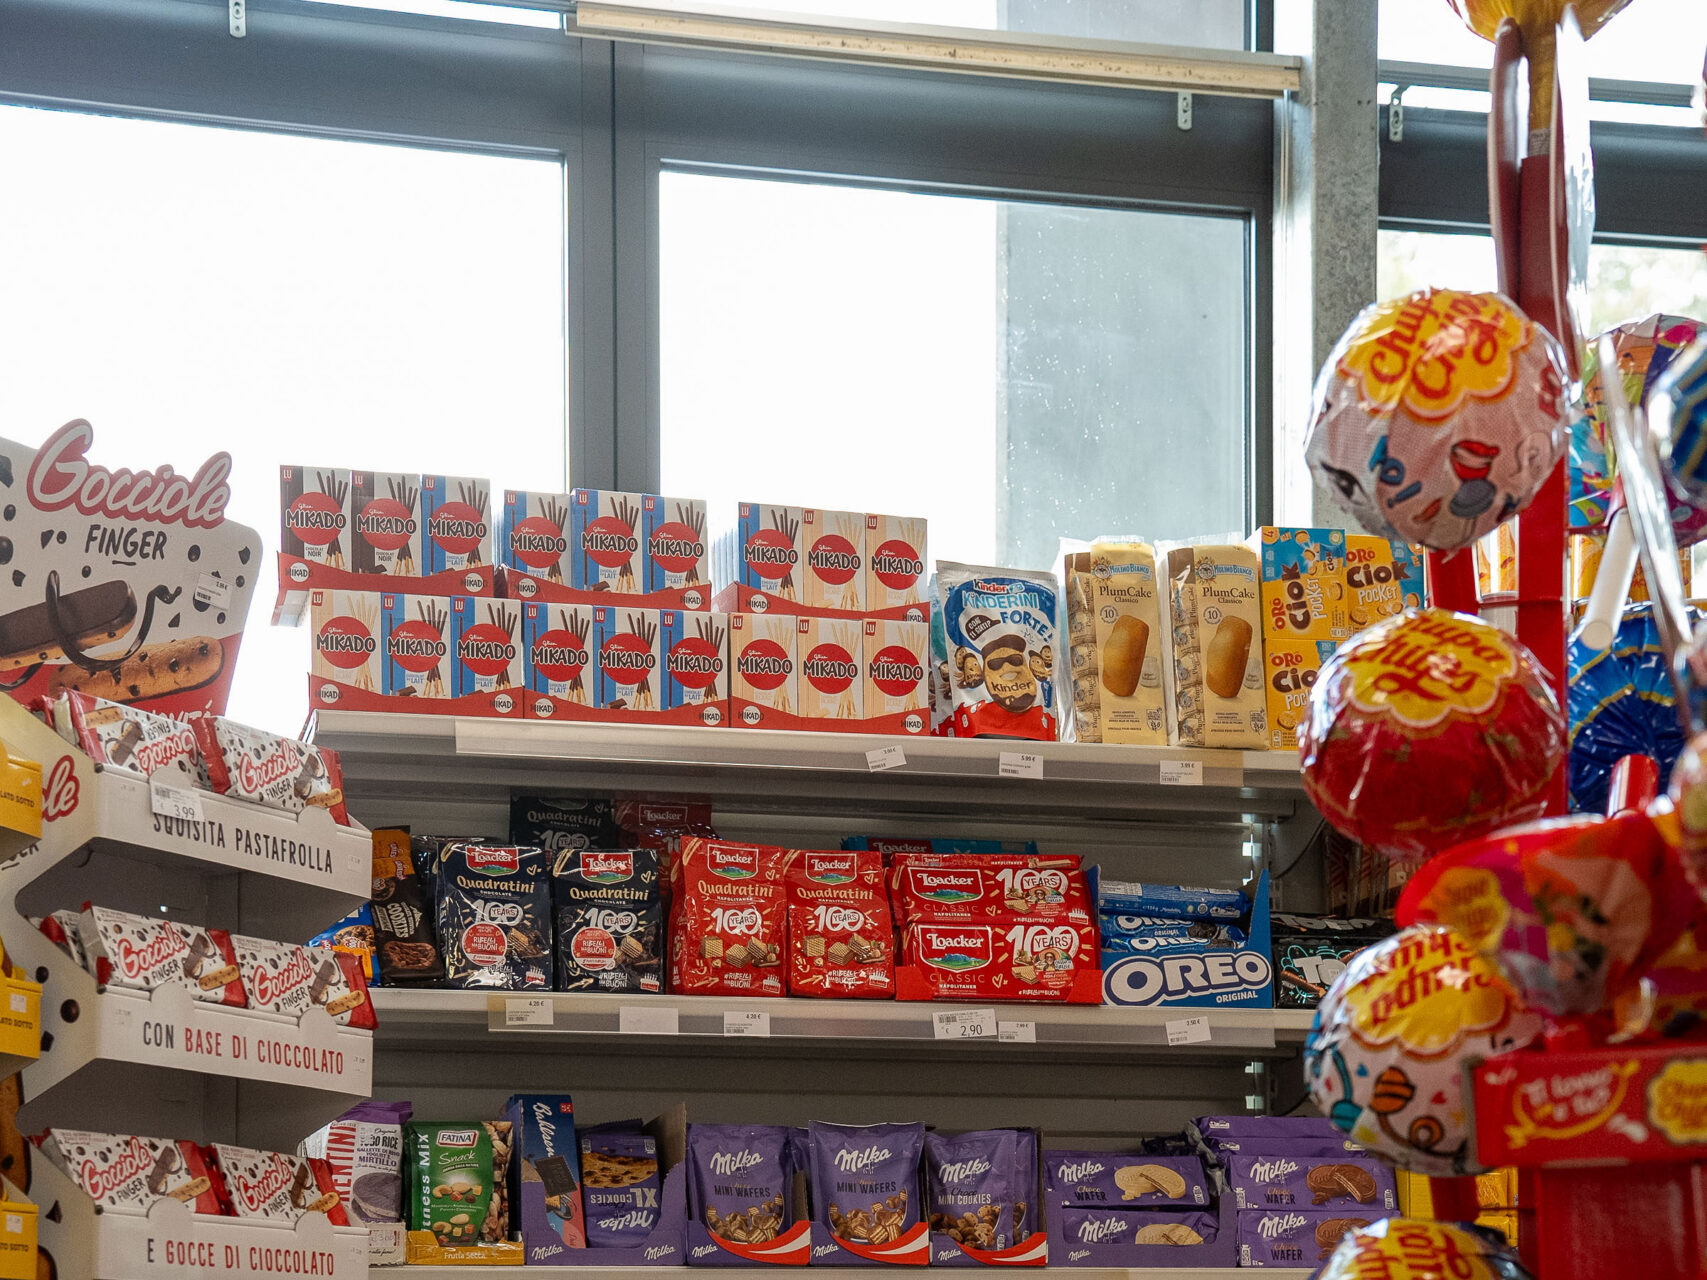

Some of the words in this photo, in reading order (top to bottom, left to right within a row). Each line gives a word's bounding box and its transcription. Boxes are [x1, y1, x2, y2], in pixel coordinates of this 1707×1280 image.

[30, 420, 231, 526] Gocciole
[283, 469, 292, 479] LU
[507, 493, 516, 504] LU
[286, 509, 347, 530] MIKADO
[357, 514, 417, 534] MIKADO
[428, 517, 487, 539] MIKADO
[85, 523, 169, 560] FINGER
[510, 531, 567, 553] MIKADO
[580, 531, 638, 553] MIKADO
[648, 537, 704, 558] MIKADO
[744, 544, 799, 564] MIKADO
[807, 550, 861, 570] MIKADO
[871, 555, 924, 575] MIKADO
[962, 591, 1040, 609] KINDERINI
[1099, 586, 1152, 598] PlumCake
[1203, 587, 1255, 599] PlumCake
[1103, 608, 1114, 618] 10
[1000, 610, 1053, 643] FORTE!
[316, 633, 376, 653] MIKADO
[387, 637, 447, 657] MIKADO
[457, 640, 516, 661] MIKADO
[530, 646, 589, 666] MIKADO
[598, 650, 656, 670] MIKADO
[666, 653, 723, 674] MIKADO
[737, 656, 793, 675] MIKADO
[803, 659, 858, 679] MIKADO
[869, 661, 924, 681] MIKADO
[239, 738, 301, 793] Gocciole
[265, 780, 292, 800] FINGER
[153, 813, 225, 849] SQUISITA
[235, 829, 333, 874] PASTAFROLLA
[470, 850, 513, 863] Loacker
[712, 850, 753, 864] Loacker
[811, 858, 851, 871] Loacker
[457, 876, 535, 894] Quadratini
[697, 879, 774, 898] Quadratini
[917, 873, 974, 887] Loacker
[1024, 876, 1058, 888] YEARS
[570, 887, 649, 903] Quadratini
[797, 887, 873, 900] Quadratini
[923, 903, 979, 913] CLASSIC
[118, 920, 186, 979] Gocciole
[926, 933, 984, 949] Loacker
[1035, 934, 1069, 948] YEARS
[152, 960, 180, 984] FINGER
[252, 946, 313, 1005] Gocciole
[929, 973, 985, 983] CLASSIC
[1104, 952, 1271, 1006] OREO
[282, 986, 308, 1010] FINGER
[1216, 991, 1258, 1004] ORIGINAL
[143, 1020, 174, 1049] CON
[185, 1027, 222, 1057] BASE
[232, 1035, 247, 1060] DI
[257, 1040, 344, 1075] CIOCCOLATO
[440, 1132, 473, 1144] FATINA
[533, 1102, 556, 1158] Bahlsen
[81, 1136, 152, 1200] Gocciole
[358, 1156, 397, 1167] MIRTILLO
[438, 1151, 476, 1166] Snack
[709, 1149, 763, 1176] Milka
[834, 1146, 892, 1173] Milka
[939, 1158, 992, 1184] Milka
[1058, 1160, 1105, 1183] Milka
[1250, 1159, 1298, 1184] Milka
[116, 1177, 147, 1203] FINGER
[237, 1152, 293, 1211] Gocciole
[714, 1184, 733, 1196] MINI
[733, 1186, 771, 1199] WAFERS
[836, 1182, 857, 1194] MINI
[858, 1181, 897, 1194] WAFERS
[633, 1188, 658, 1209] XL
[938, 1194, 955, 1206] MINI
[957, 1193, 991, 1205] COOKIES
[1075, 1191, 1108, 1202] WAFER
[597, 1208, 654, 1230] Milka
[1257, 1212, 1308, 1238] Milka
[1079, 1218, 1128, 1243] Milka
[147, 1238, 155, 1263] E
[165, 1239, 215, 1268] GOCCE
[225, 1245, 240, 1270] DI
[250, 1247, 335, 1277] CIOCCOLATO
[531, 1243, 564, 1261] Milka
[644, 1243, 675, 1261] Milka
[692, 1244, 718, 1258] Milka
[813, 1244, 839, 1257] Milka
